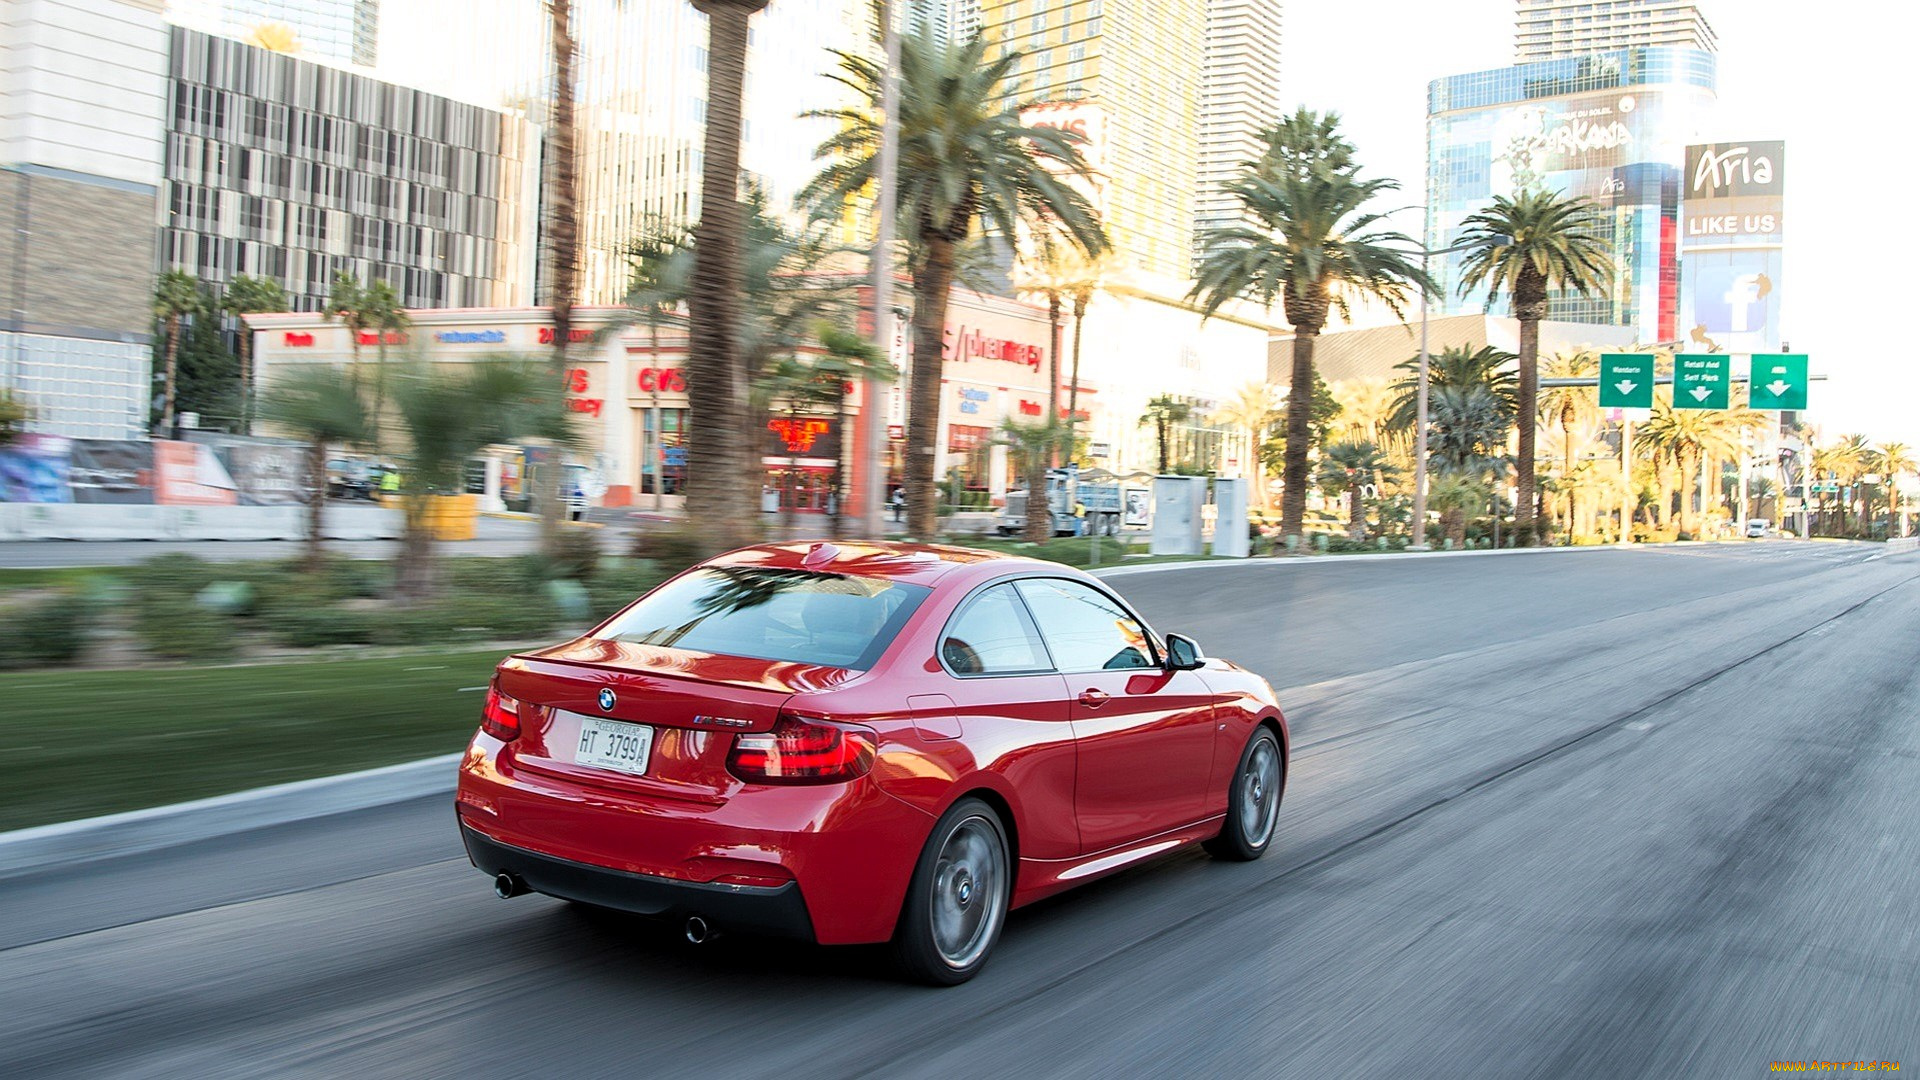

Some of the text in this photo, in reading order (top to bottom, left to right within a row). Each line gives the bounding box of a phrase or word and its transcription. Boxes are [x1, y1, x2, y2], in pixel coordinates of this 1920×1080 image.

[1693, 146, 1773, 191] Aria
[1689, 214, 1776, 235] LIKE US
[941, 324, 1043, 374] S/pharmacy
[638, 367, 687, 392] CVS
[599, 721, 637, 736] GEORGIA
[579, 729, 599, 754] HT
